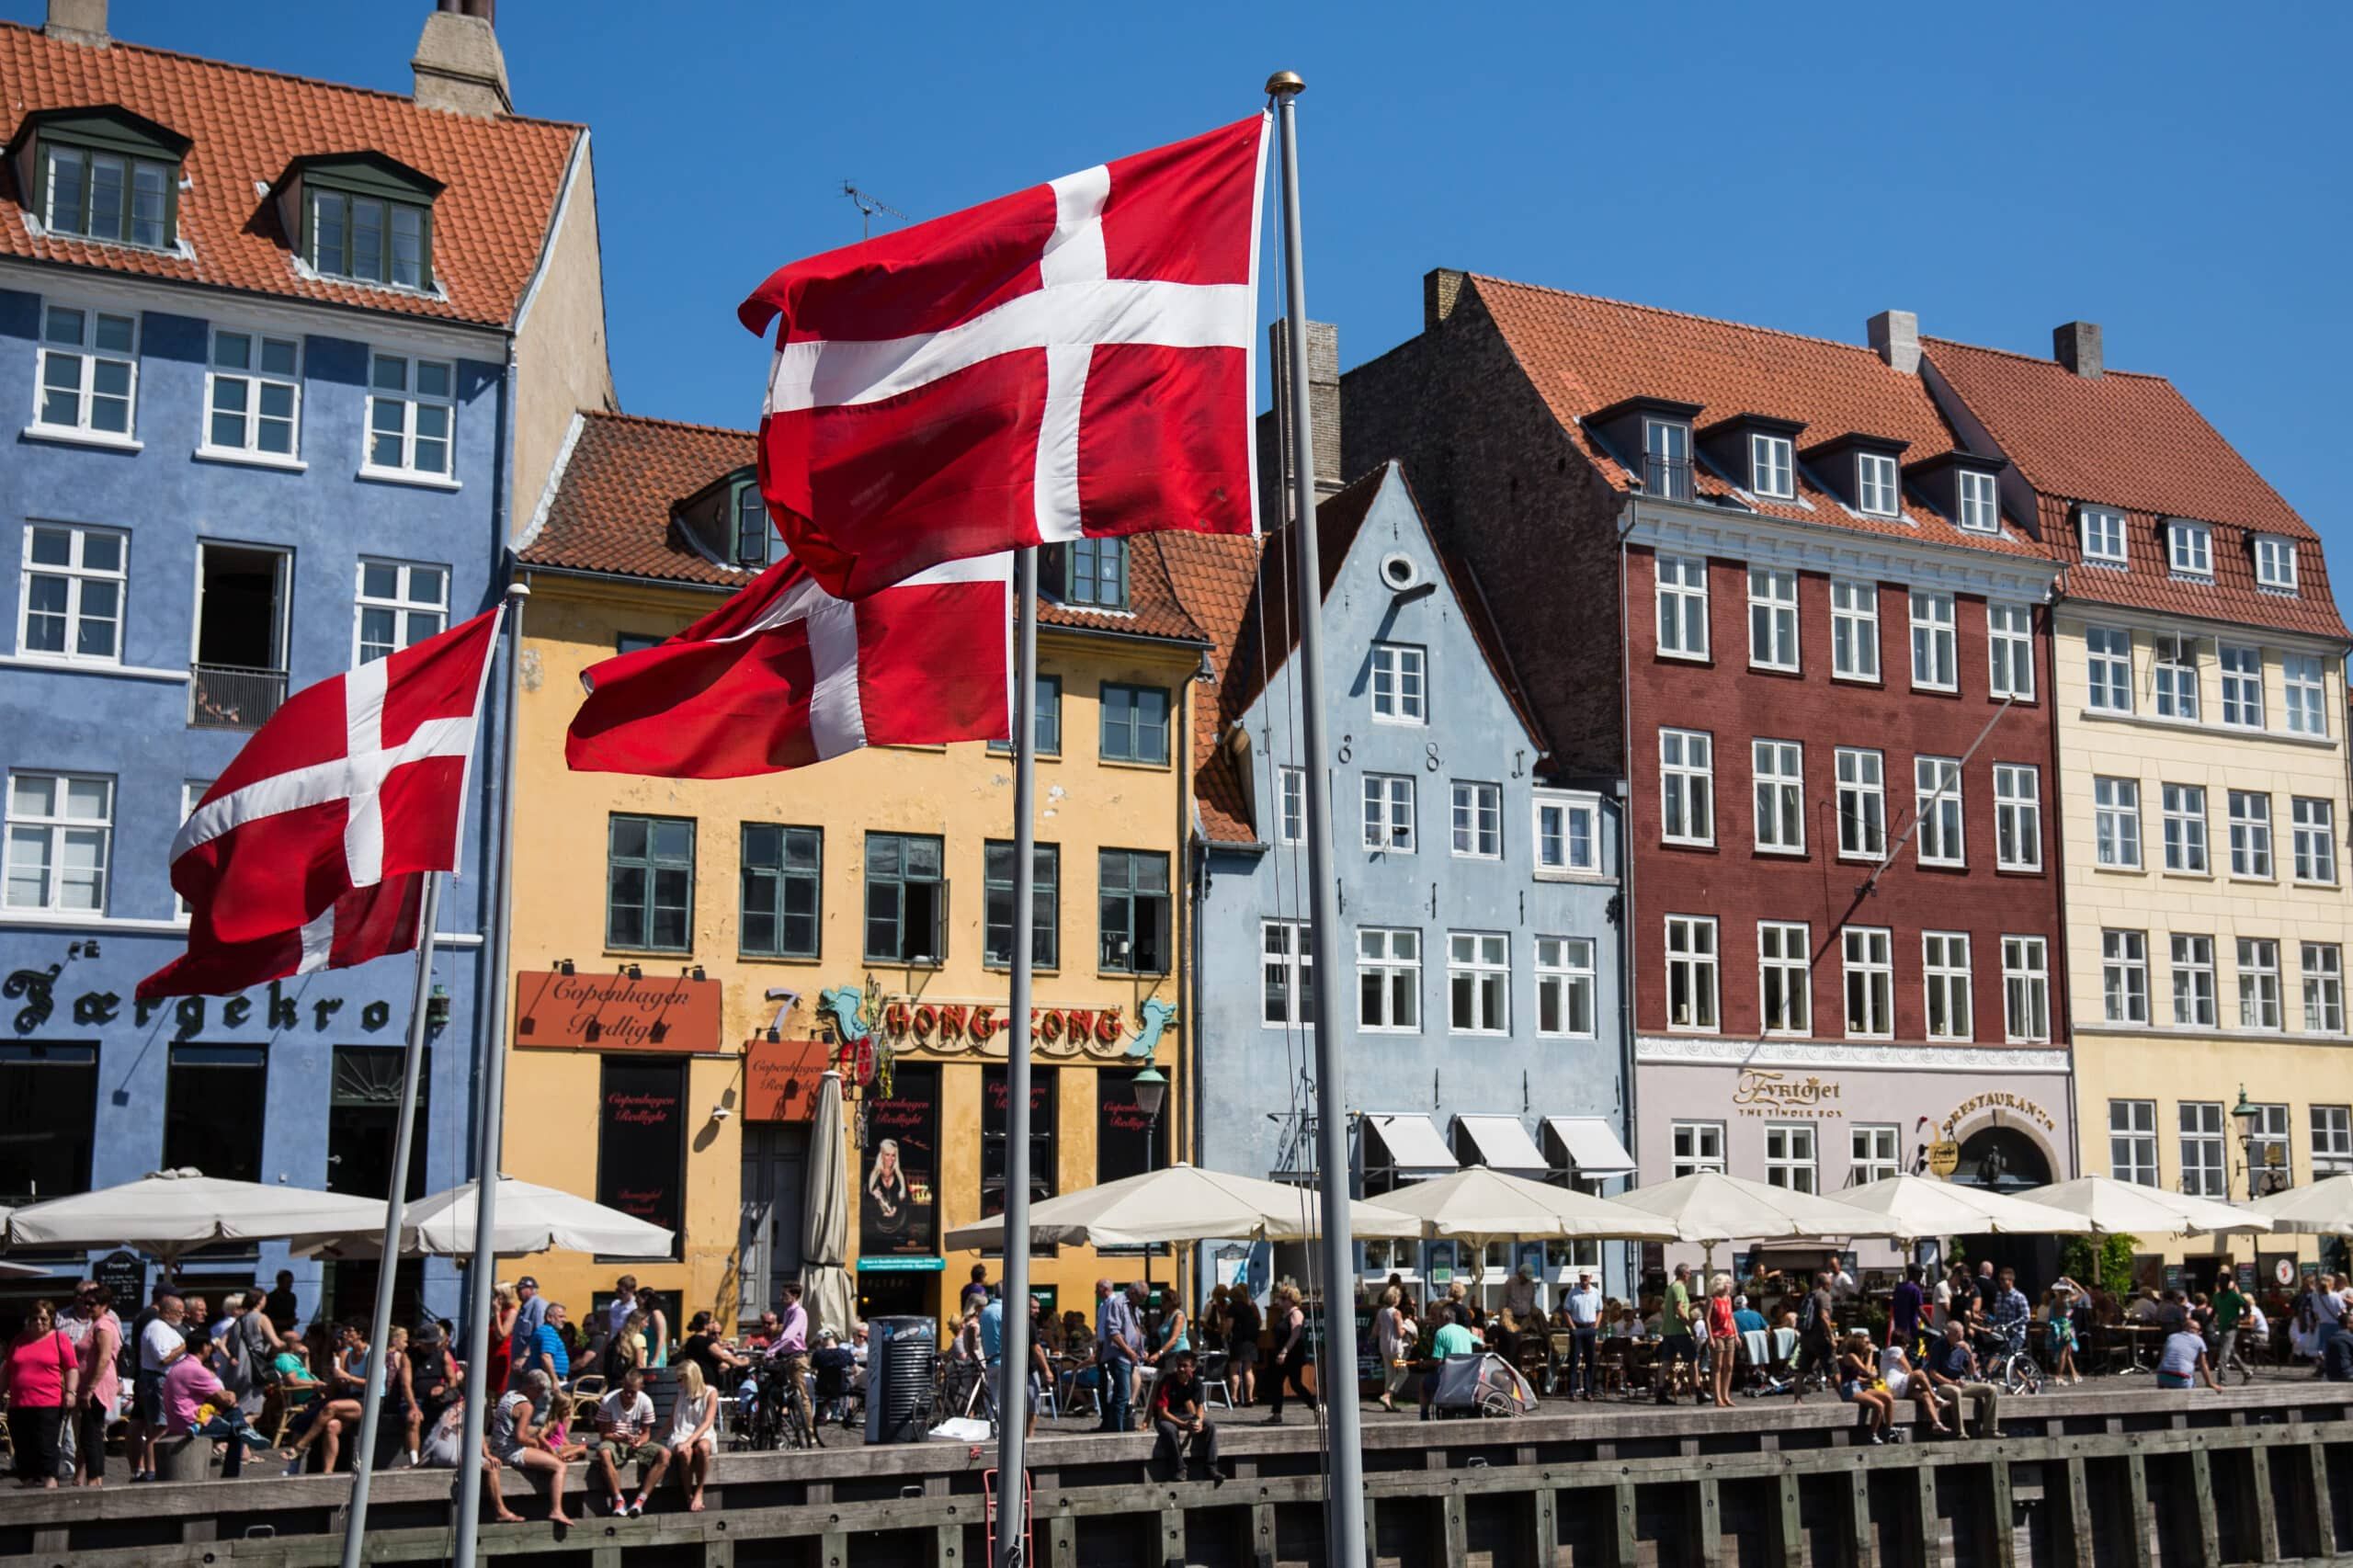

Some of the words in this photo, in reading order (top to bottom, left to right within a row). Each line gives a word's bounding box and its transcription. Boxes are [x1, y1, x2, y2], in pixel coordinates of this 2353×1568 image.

[553, 978, 689, 1012] Copenhagen
[768, 987, 801, 1032] 7
[565, 1013, 672, 1045] Redligt
[753, 1059, 824, 1077] Copenhagen
[1739, 1108, 1762, 1118] THE
